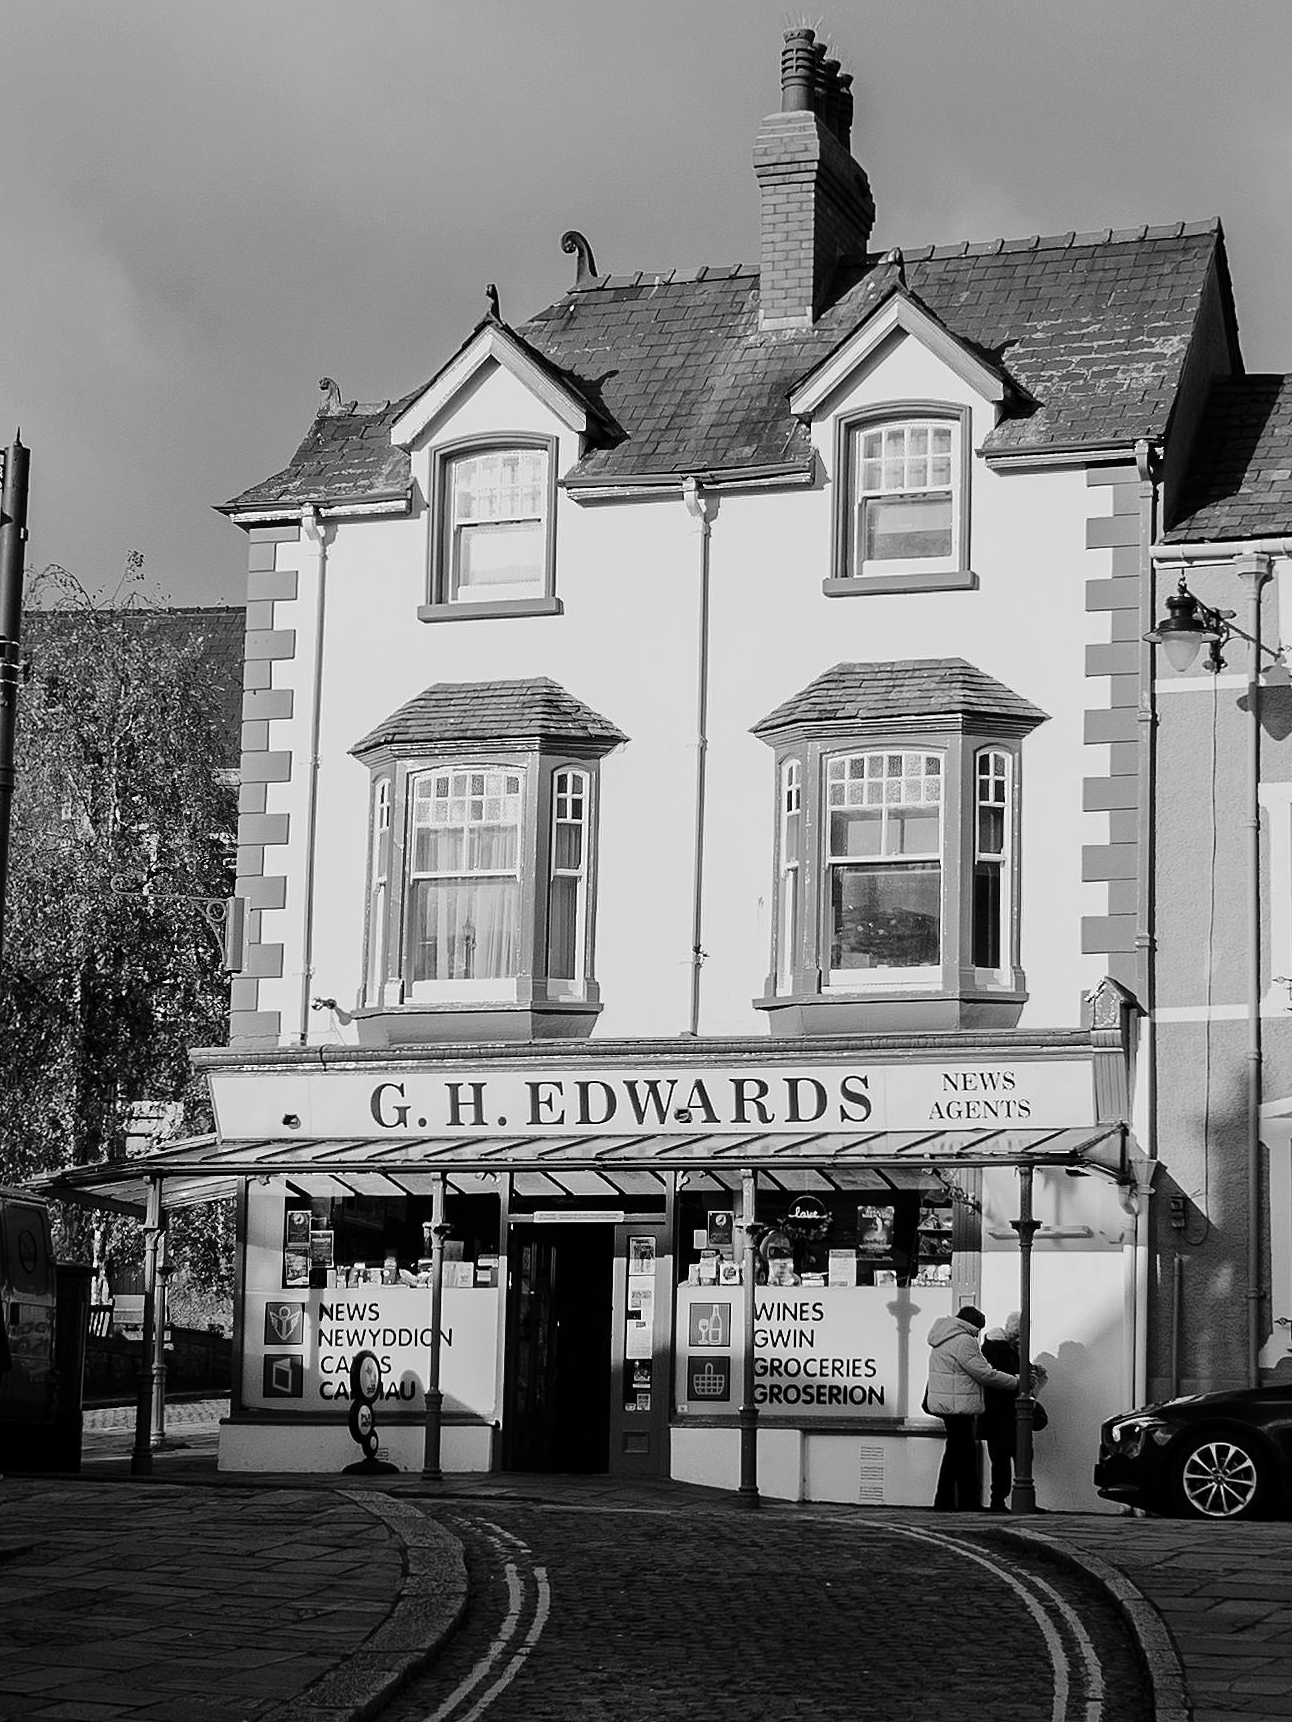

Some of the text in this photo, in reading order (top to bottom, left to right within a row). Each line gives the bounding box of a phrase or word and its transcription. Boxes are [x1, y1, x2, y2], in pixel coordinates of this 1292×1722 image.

[941, 1071, 1016, 1091] NEWS
[524, 1074, 873, 1126] EDWARDS
[929, 1098, 1031, 1120] AGENTS
[319, 1303, 380, 1322] NEWS
[754, 1302, 824, 1321] WINES
[318, 1328, 453, 1347] NEWYDDION
[754, 1329, 815, 1348] GWIN
[320, 1355, 392, 1375] CAS
[754, 1357, 877, 1377] GROCERIES
[319, 1381, 416, 1401] CAIAU
[754, 1384, 885, 1405] GROSERION
